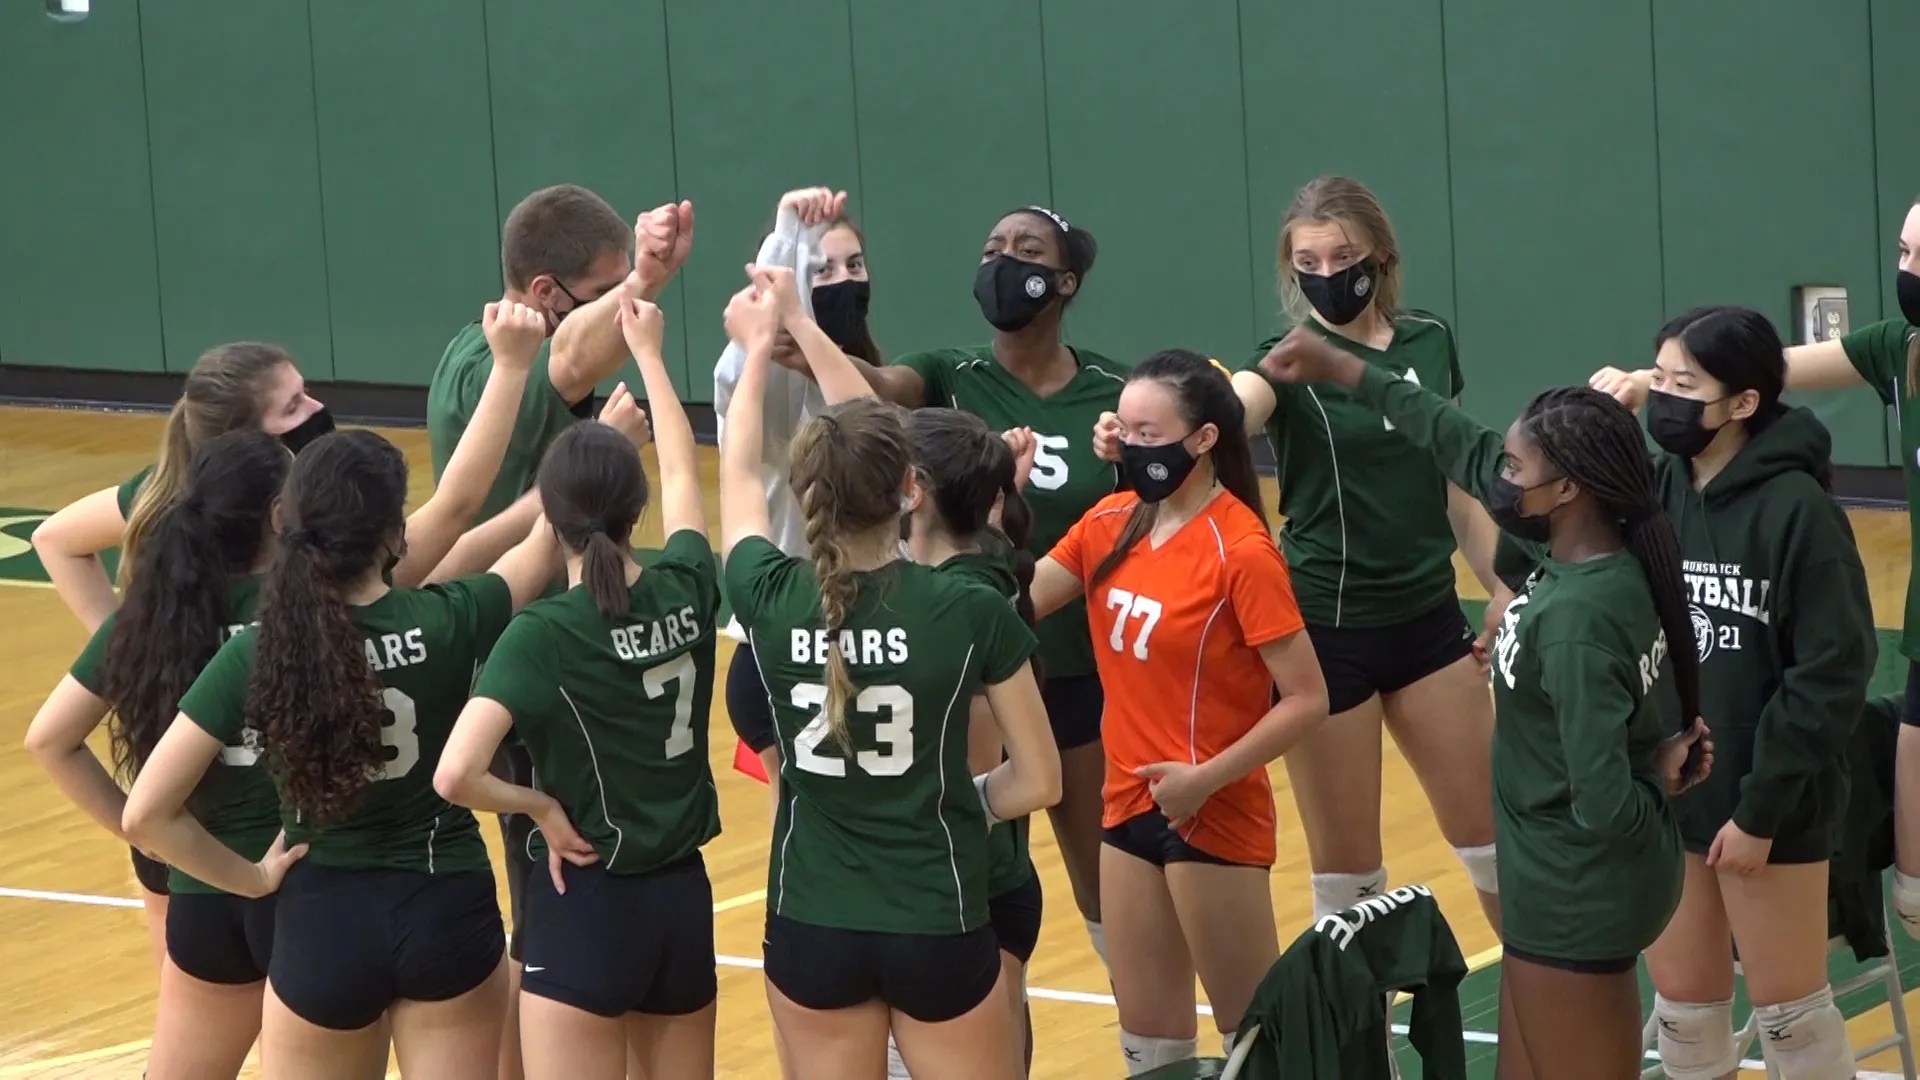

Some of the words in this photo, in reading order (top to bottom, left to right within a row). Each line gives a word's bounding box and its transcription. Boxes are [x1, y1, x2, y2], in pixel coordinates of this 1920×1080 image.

[1682, 560, 1741, 576] RUNSWICK
[1107, 587, 1162, 661] 77
[1683, 573, 1770, 625] YBALL
[365, 627, 427, 671] ARS
[610, 605, 700, 660] BEARS
[791, 627, 908, 664] BEARS
[1718, 625, 1742, 650] 21
[642, 651, 697, 760] 7
[790, 682, 914, 777] 23
